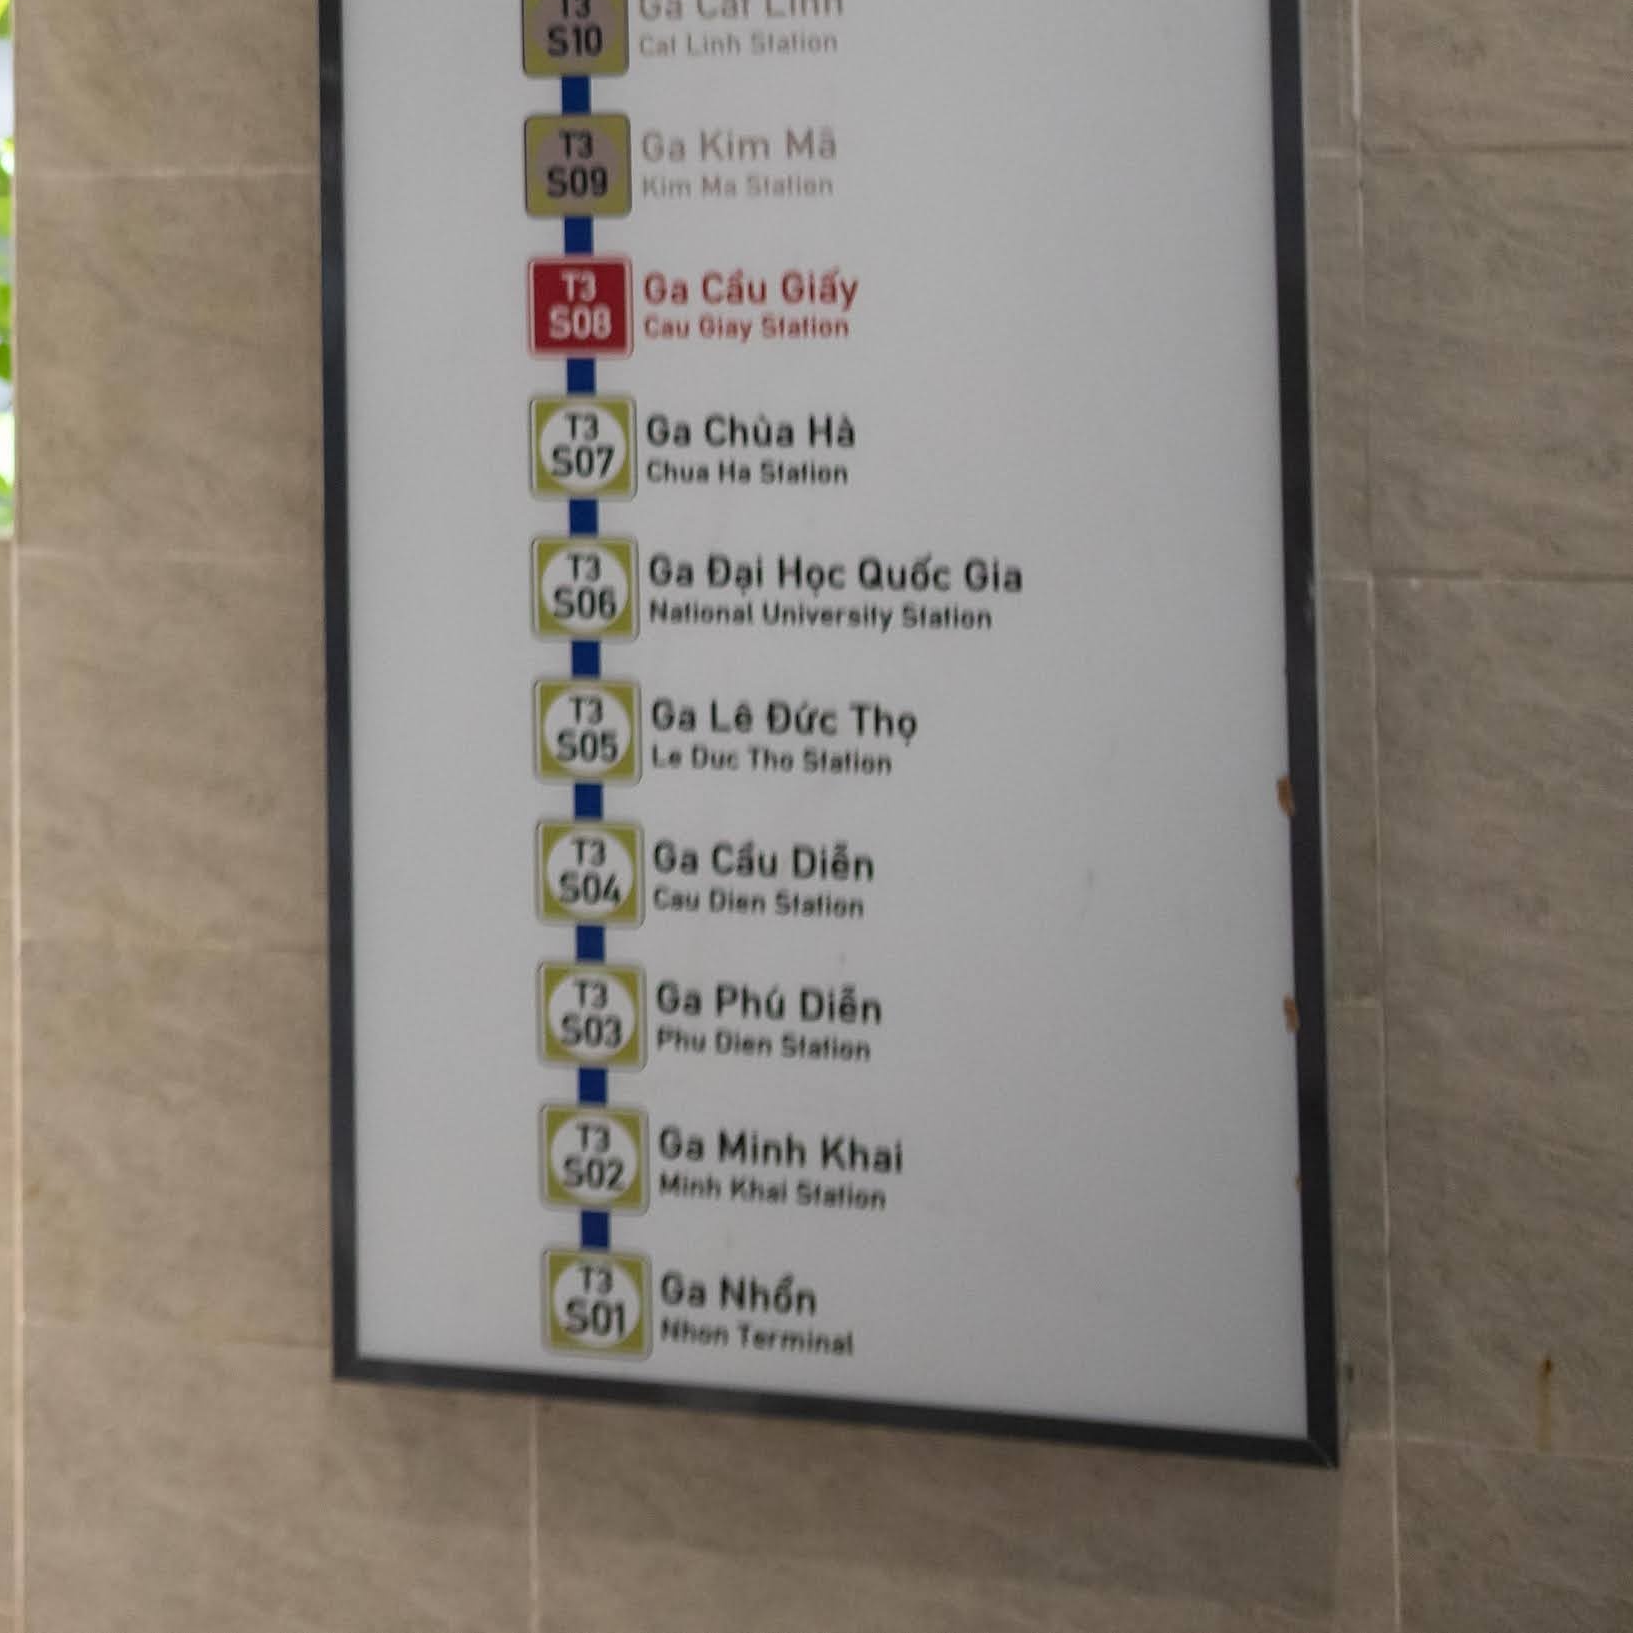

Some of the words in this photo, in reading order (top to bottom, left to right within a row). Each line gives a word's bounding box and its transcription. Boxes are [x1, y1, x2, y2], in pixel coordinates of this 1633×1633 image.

[548, 25, 603, 57] S10
[639, 36, 676, 57] Cat
[687, 35, 741, 55] Linh
[750, 32, 838, 54] Station
[559, 131, 593, 160] T3
[642, 132, 686, 162] Ga
[700, 130, 770, 161] Kim
[548, 167, 609, 198] S09
[643, 177, 691, 199] Kim
[702, 176, 736, 197] Ma
[746, 174, 834, 197] Station
[561, 271, 597, 302] T3
[644, 272, 689, 304] Ga
[548, 305, 612, 340] S08
[645, 317, 689, 338] Cau
[699, 316, 752, 343] Giay
[761, 315, 849, 337] Station
[565, 414, 599, 441] T3
[647, 415, 691, 447] Ga
[705, 414, 794, 447] Chùa
[809, 412, 855, 448] Hà
[551, 447, 615, 479] S07
[646, 460, 709, 483] Chua
[719, 461, 751, 484] Ha
[760, 461, 848, 485] Station
[567, 553, 602, 581] T3
[649, 553, 694, 587] Ga
[707, 553, 763, 597] Đại
[778, 556, 845, 599] Học
[858, 552, 952, 593] Quốc
[965, 559, 1023, 593] Gia
[554, 588, 616, 620] S06
[649, 602, 753, 624] National
[763, 603, 894, 633] University
[902, 606, 992, 630] Station
[569, 697, 604, 725] T3
[652, 698, 696, 731] Ga
[711, 698, 753, 734] Lê
[766, 701, 837, 736] Đức
[849, 702, 918, 746] Thọ
[557, 734, 618, 763] S05
[652, 747, 682, 767] Le
[692, 746, 738, 769] Duc
[747, 747, 794, 771] Tho
[803, 749, 892, 774] Station
[570, 839, 606, 866] T3
[654, 840, 698, 874] Ga
[559, 874, 620, 906] S04
[654, 888, 699, 912] Cau
[709, 890, 765, 915] Dien
[775, 894, 864, 918] Station
[573, 981, 608, 1008] T3
[657, 981, 702, 1016] Ga
[715, 983, 785, 1019] Phú
[561, 1015, 622, 1048] S03
[656, 1028, 705, 1052] Phu
[715, 1031, 772, 1056] Dien
[781, 1034, 870, 1060] Station
[576, 1124, 610, 1153] T3
[660, 1126, 704, 1161] Ga
[719, 1129, 806, 1169] Minh
[821, 1137, 903, 1174] Khai
[563, 1157, 624, 1190] S02
[660, 1174, 721, 1199] Minh
[729, 1180, 787, 1204] Khai
[795, 1184, 886, 1210] Station
[578, 1267, 613, 1295] T3
[661, 1272, 705, 1308] Ga
[566, 1299, 627, 1337] S01
[661, 1319, 728, 1347] Nhon
[739, 1326, 853, 1356] Terminal
